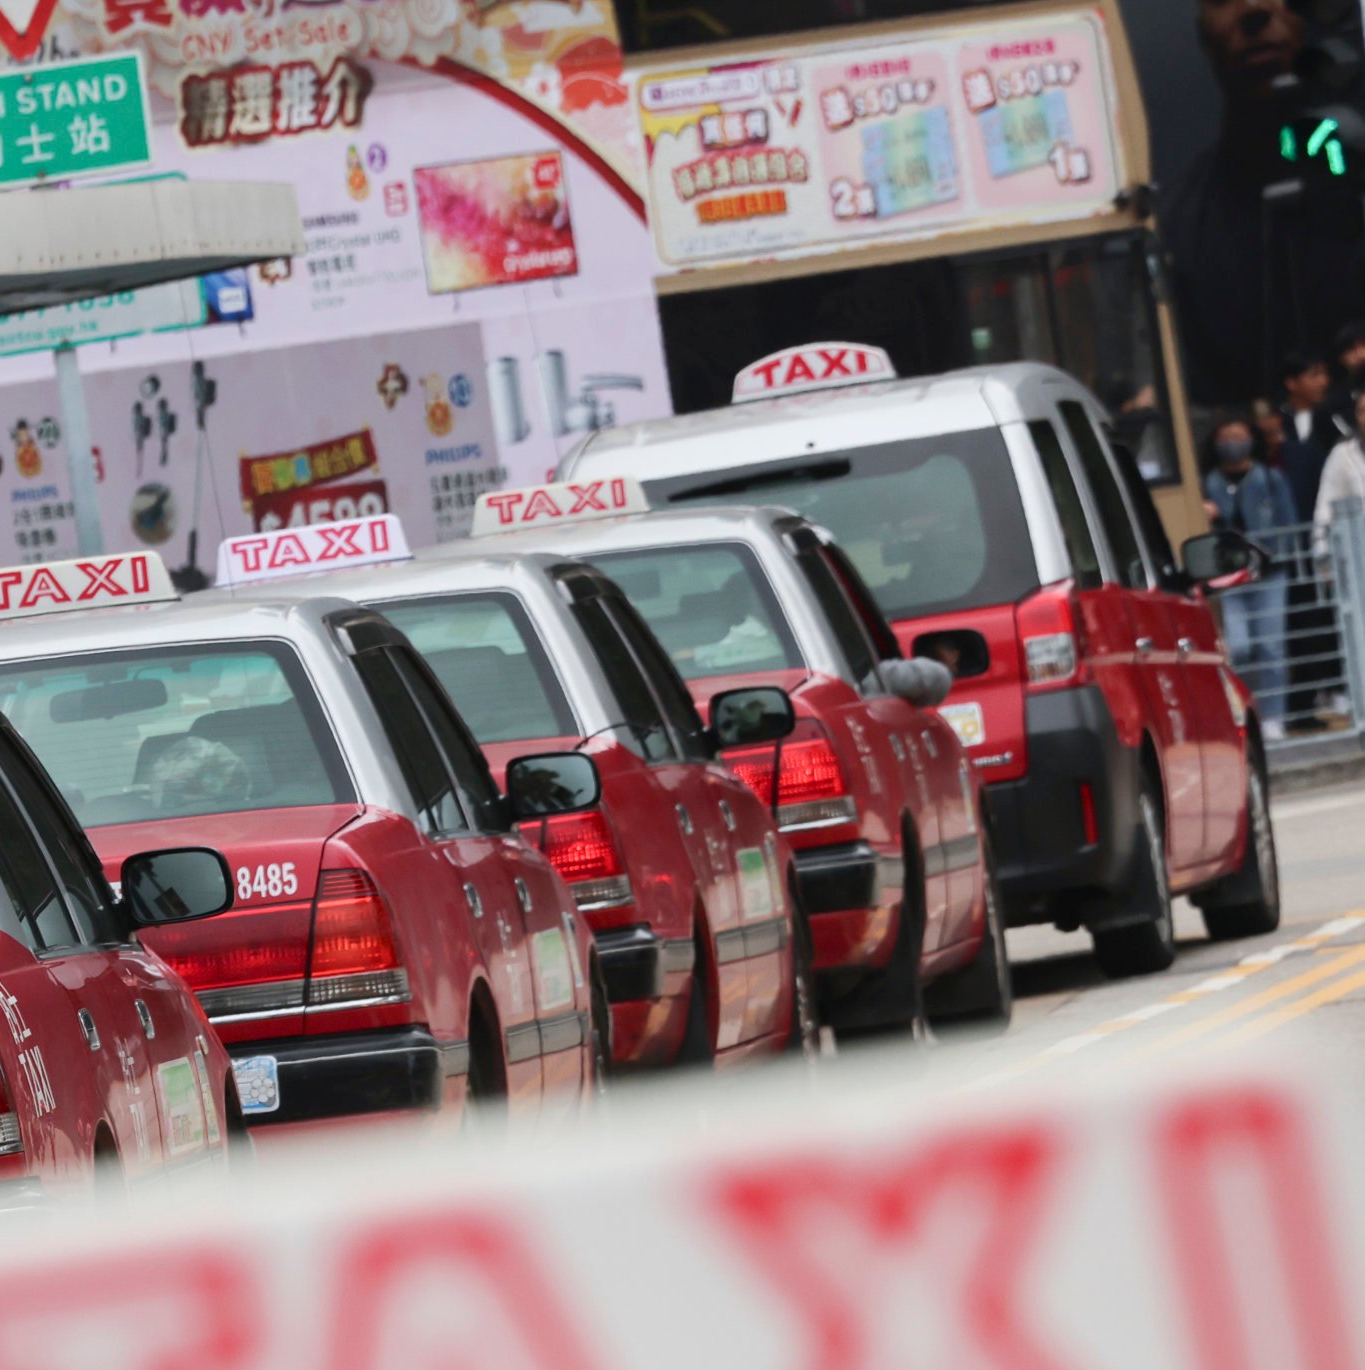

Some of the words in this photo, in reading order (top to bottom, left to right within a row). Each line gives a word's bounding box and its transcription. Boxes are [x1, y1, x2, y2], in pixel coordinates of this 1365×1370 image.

[182, 27, 232, 61] CNY
[244, 26, 284, 54] Set
[298, 19, 351, 46] Sale
[15, 74, 128, 115] STAND
[182, 60, 364, 144] 精選推介
[751, 350, 870, 390] TAXI
[486, 478, 627, 525] TAXI
[231, 520, 389, 572] TAXI
[236, 862, 299, 900] 8485
[17, 1045, 57, 1118] TAXI
